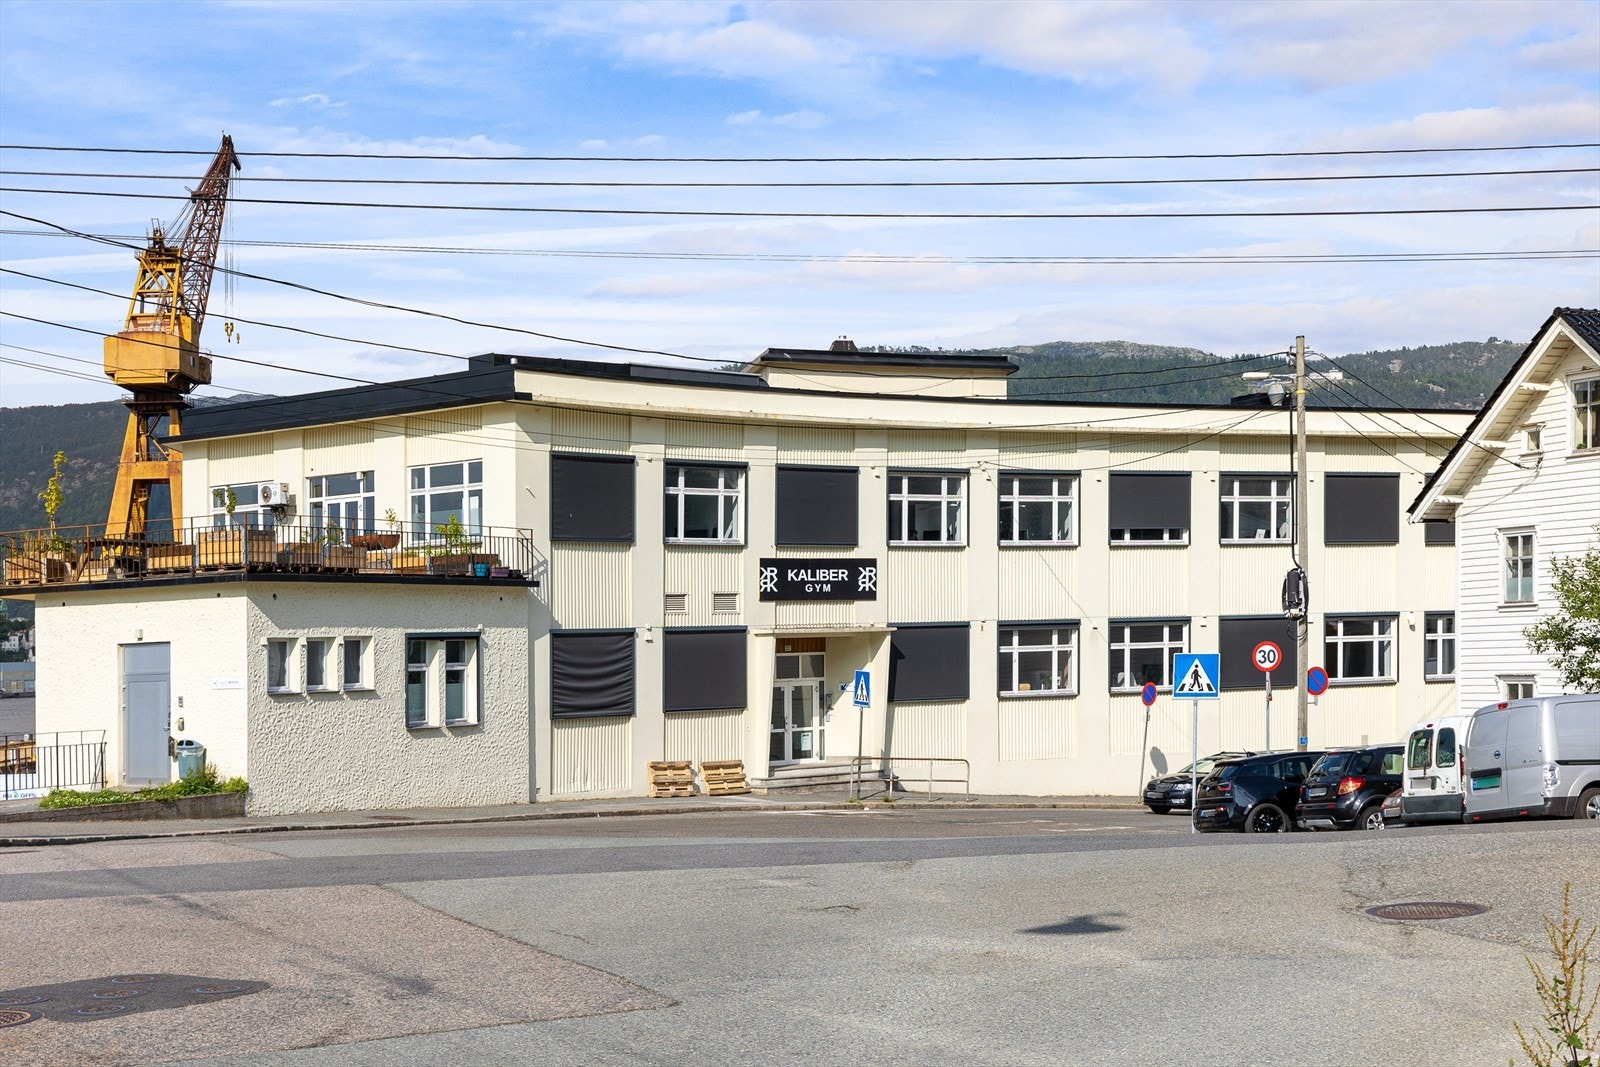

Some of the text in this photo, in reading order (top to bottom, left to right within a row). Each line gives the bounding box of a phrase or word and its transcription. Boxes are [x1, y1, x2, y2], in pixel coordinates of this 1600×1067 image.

[787, 569, 848, 581] KALIBER
[805, 583, 831, 593] GYM
[1258, 649, 1276, 664] 30
